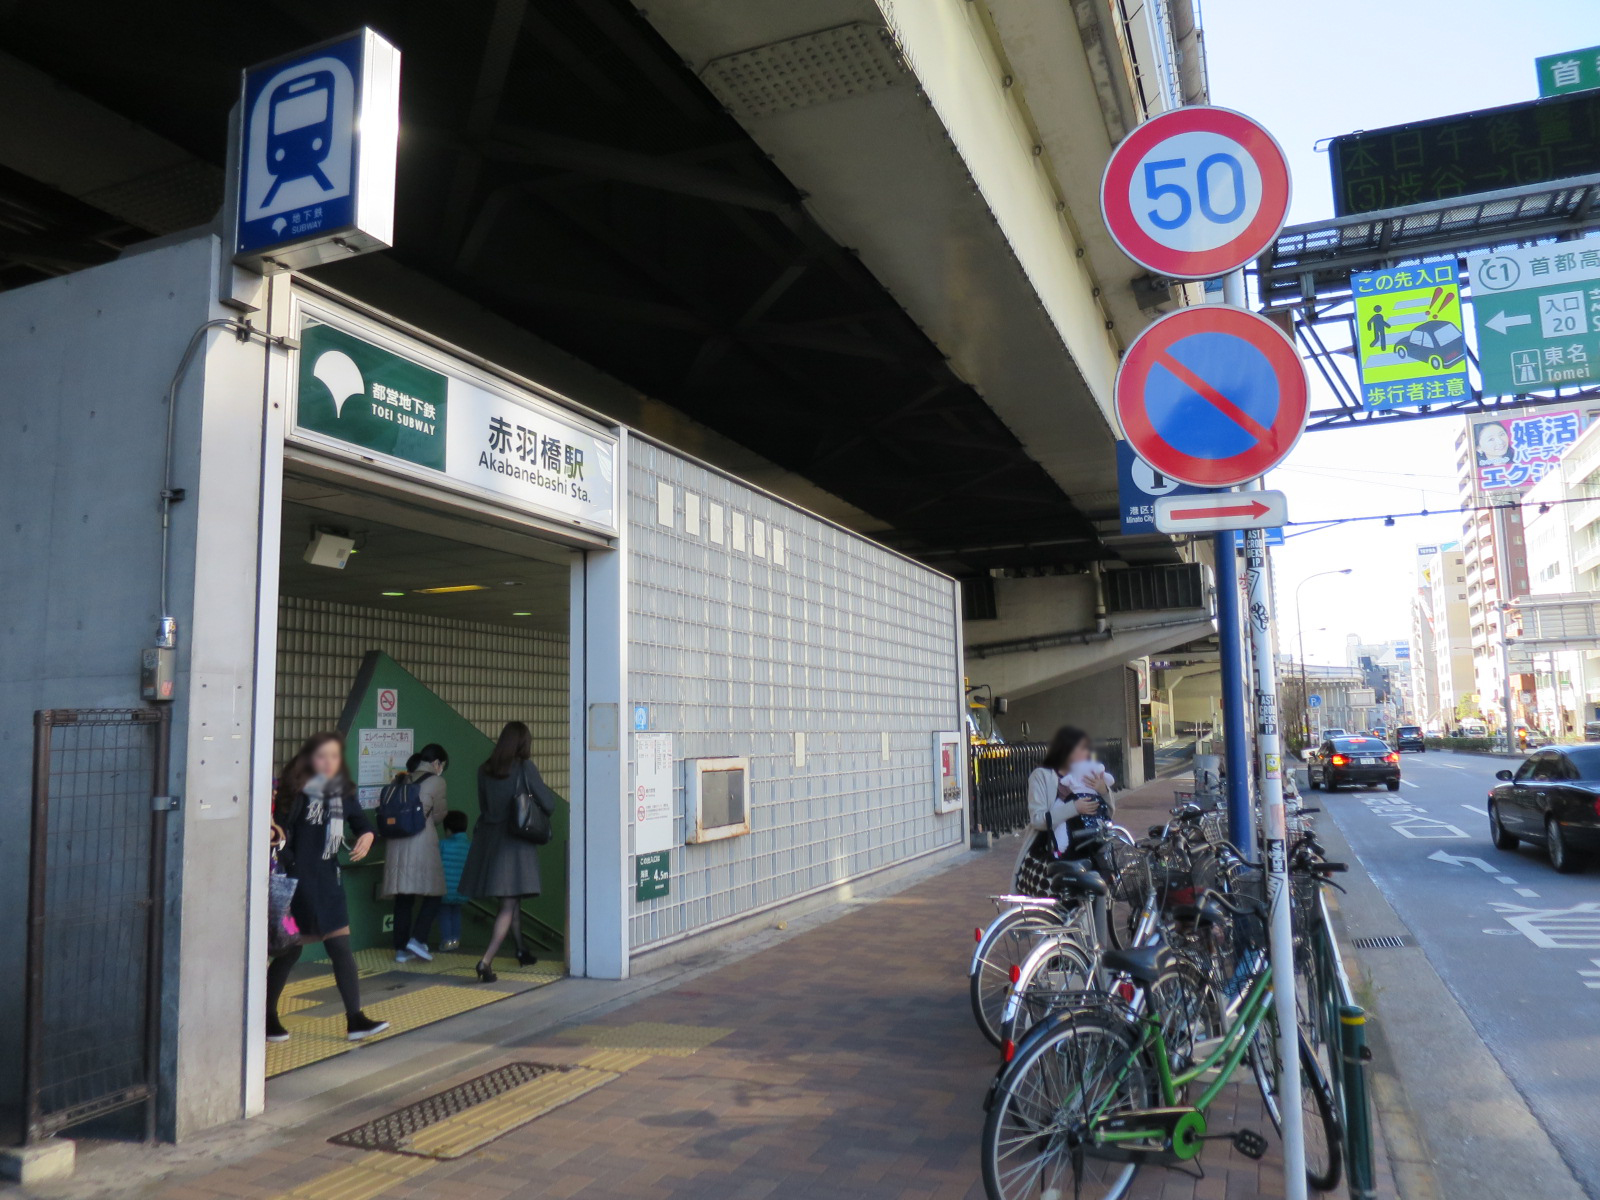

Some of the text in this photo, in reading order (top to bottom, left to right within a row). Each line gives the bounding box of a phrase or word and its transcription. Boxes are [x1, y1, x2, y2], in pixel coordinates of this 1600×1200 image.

[1143, 152, 1246, 231] 50
[291, 207, 323, 224] 地下鉄
[291, 220, 323, 235] SUBWAY
[1486, 249, 1600, 282] C1 首都高
[1358, 266, 1453, 294] この先入口
[1545, 296, 1580, 314] 入口
[1553, 316, 1576, 333] 20
[1543, 344, 1587, 367] 東名
[1545, 364, 1590, 382] Tomei
[372, 382, 436, 421] 都営地下鉄
[1367, 377, 1466, 406] 歩行者注意
[371, 403, 436, 436] TOEI SUBWAY
[1512, 412, 1579, 449] 婚活
[488, 416, 584, 482] 赤羽橋駅
[478, 450, 592, 504] Akabanebashi Sta.
[1126, 516, 1144, 524] Minato
[1129, 505, 1154, 516] 港区
